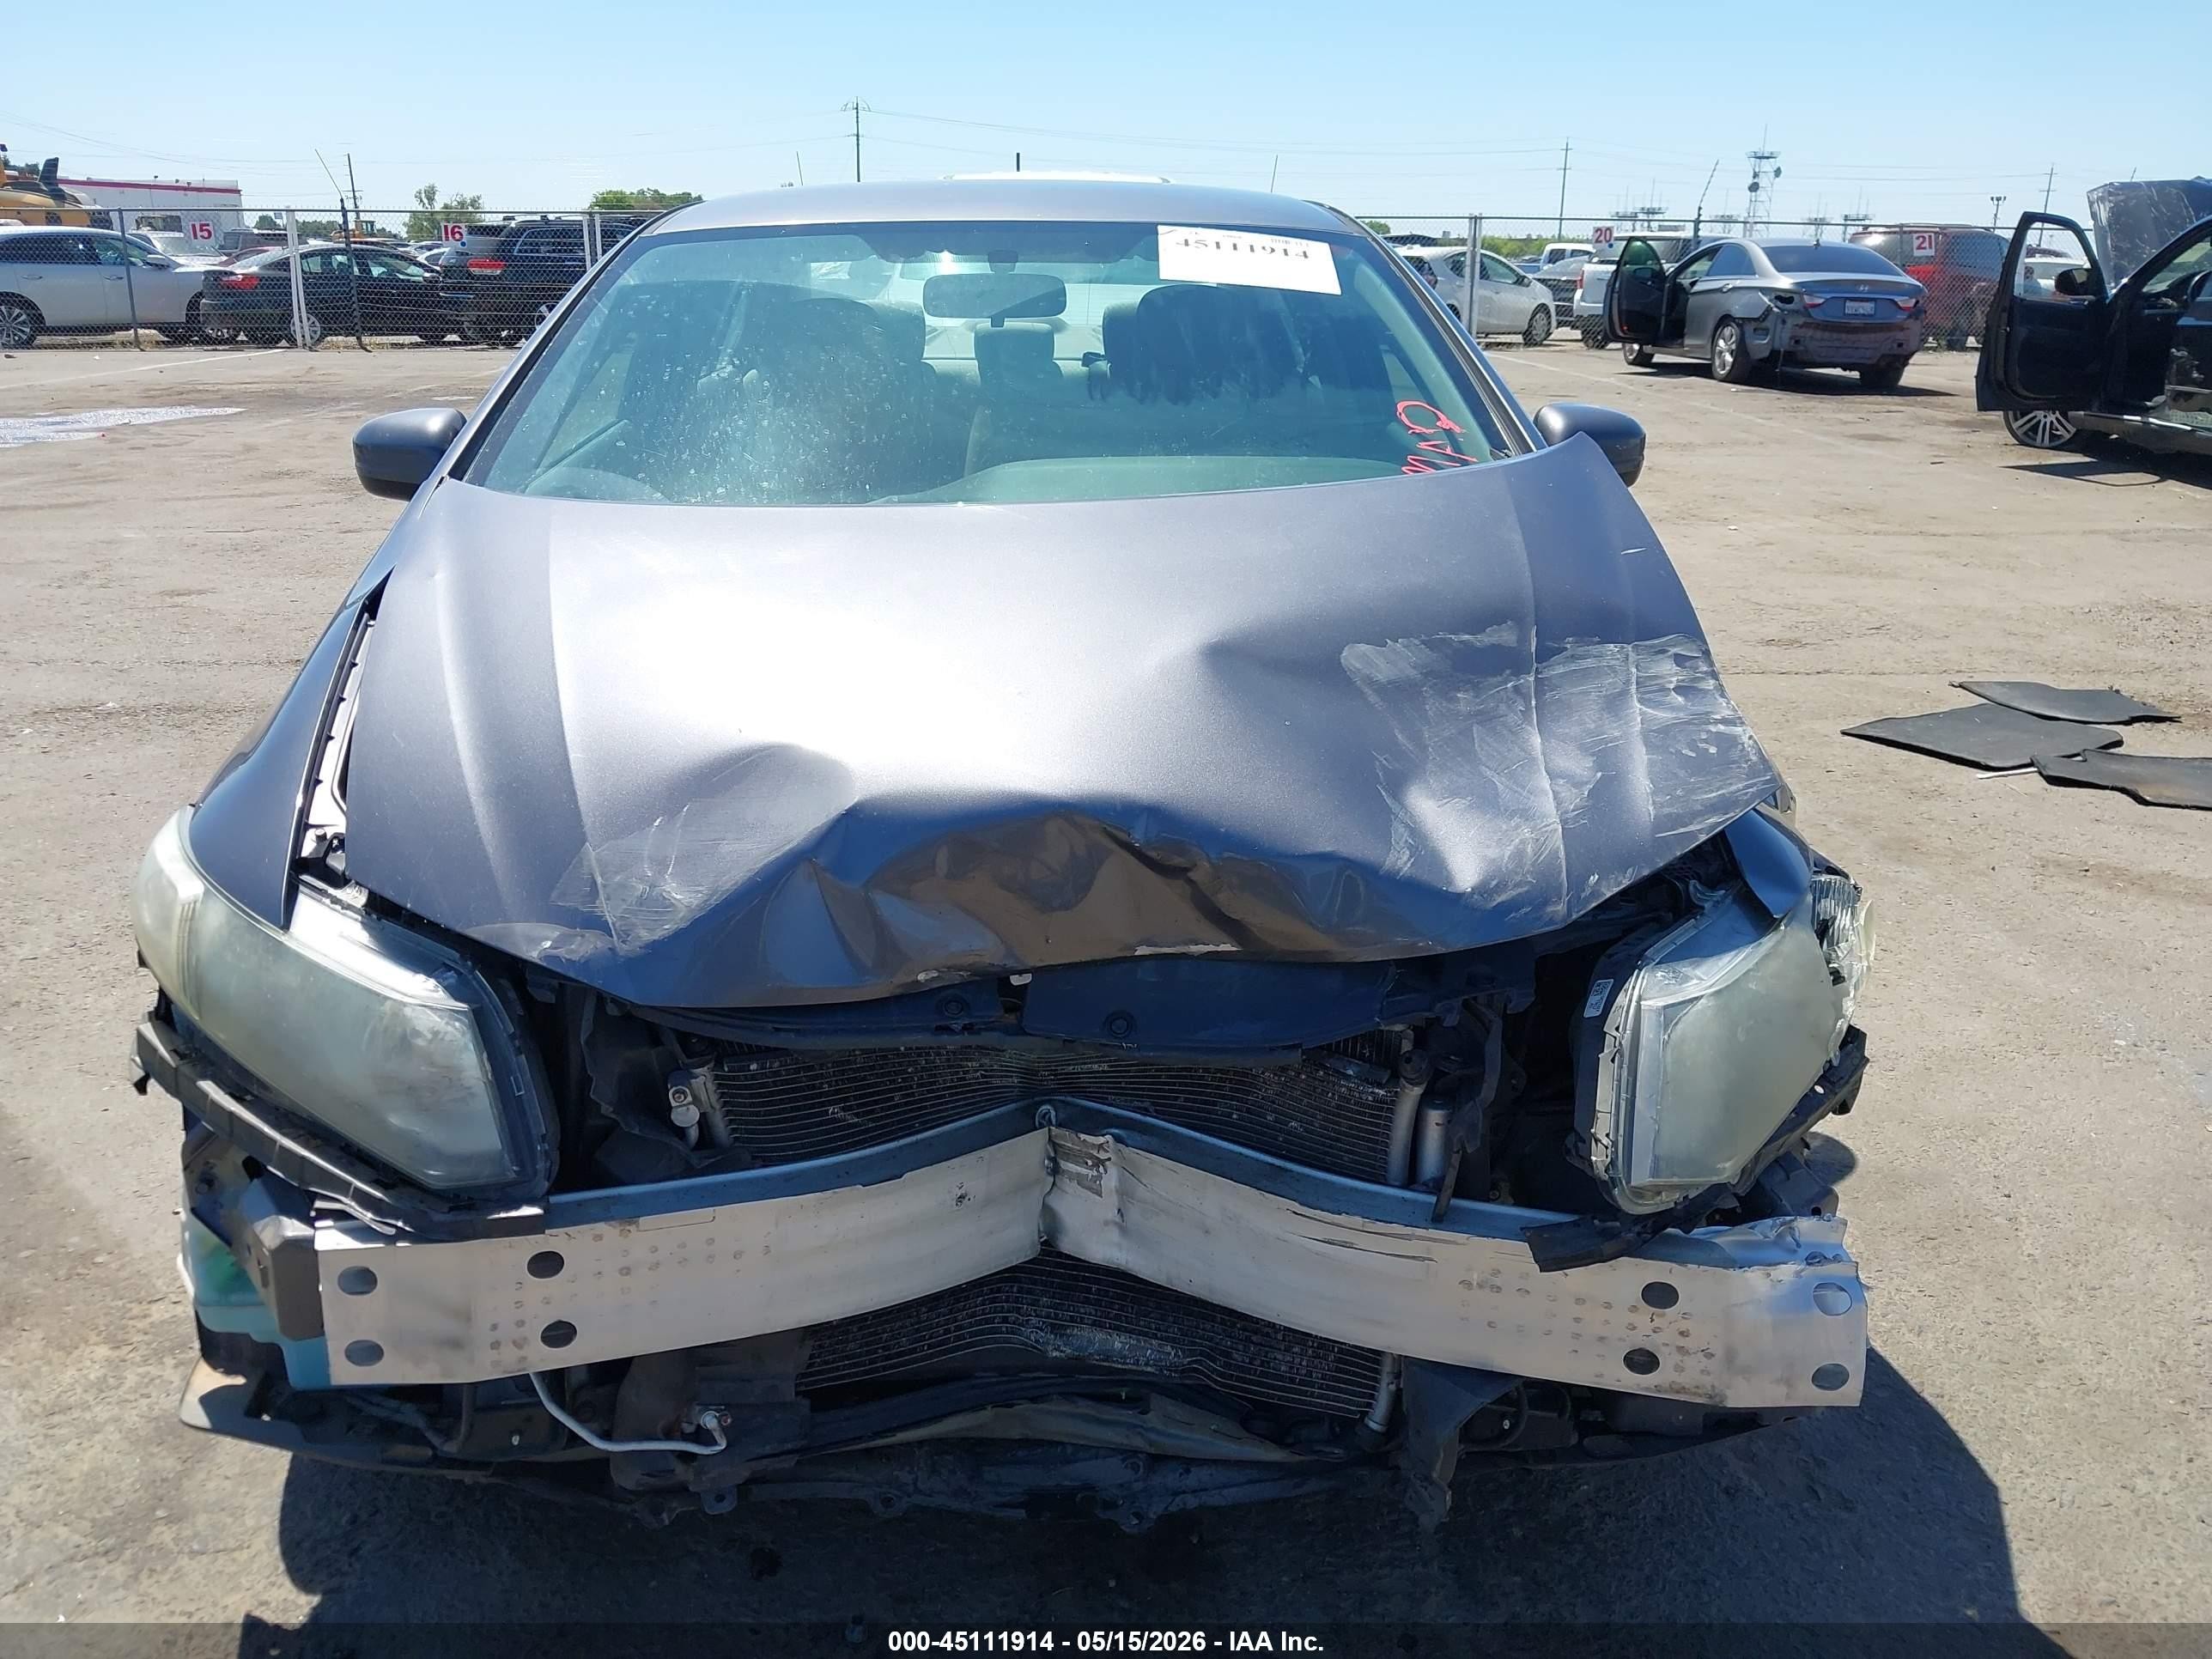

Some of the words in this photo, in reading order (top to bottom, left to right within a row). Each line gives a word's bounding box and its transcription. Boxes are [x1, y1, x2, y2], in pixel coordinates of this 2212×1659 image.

[191, 223, 212, 240] 15
[444, 225, 464, 241] 16
[1594, 228, 1612, 243] 20
[1176, 238, 1310, 259] 45111914
[1916, 234, 1933, 250] 21
